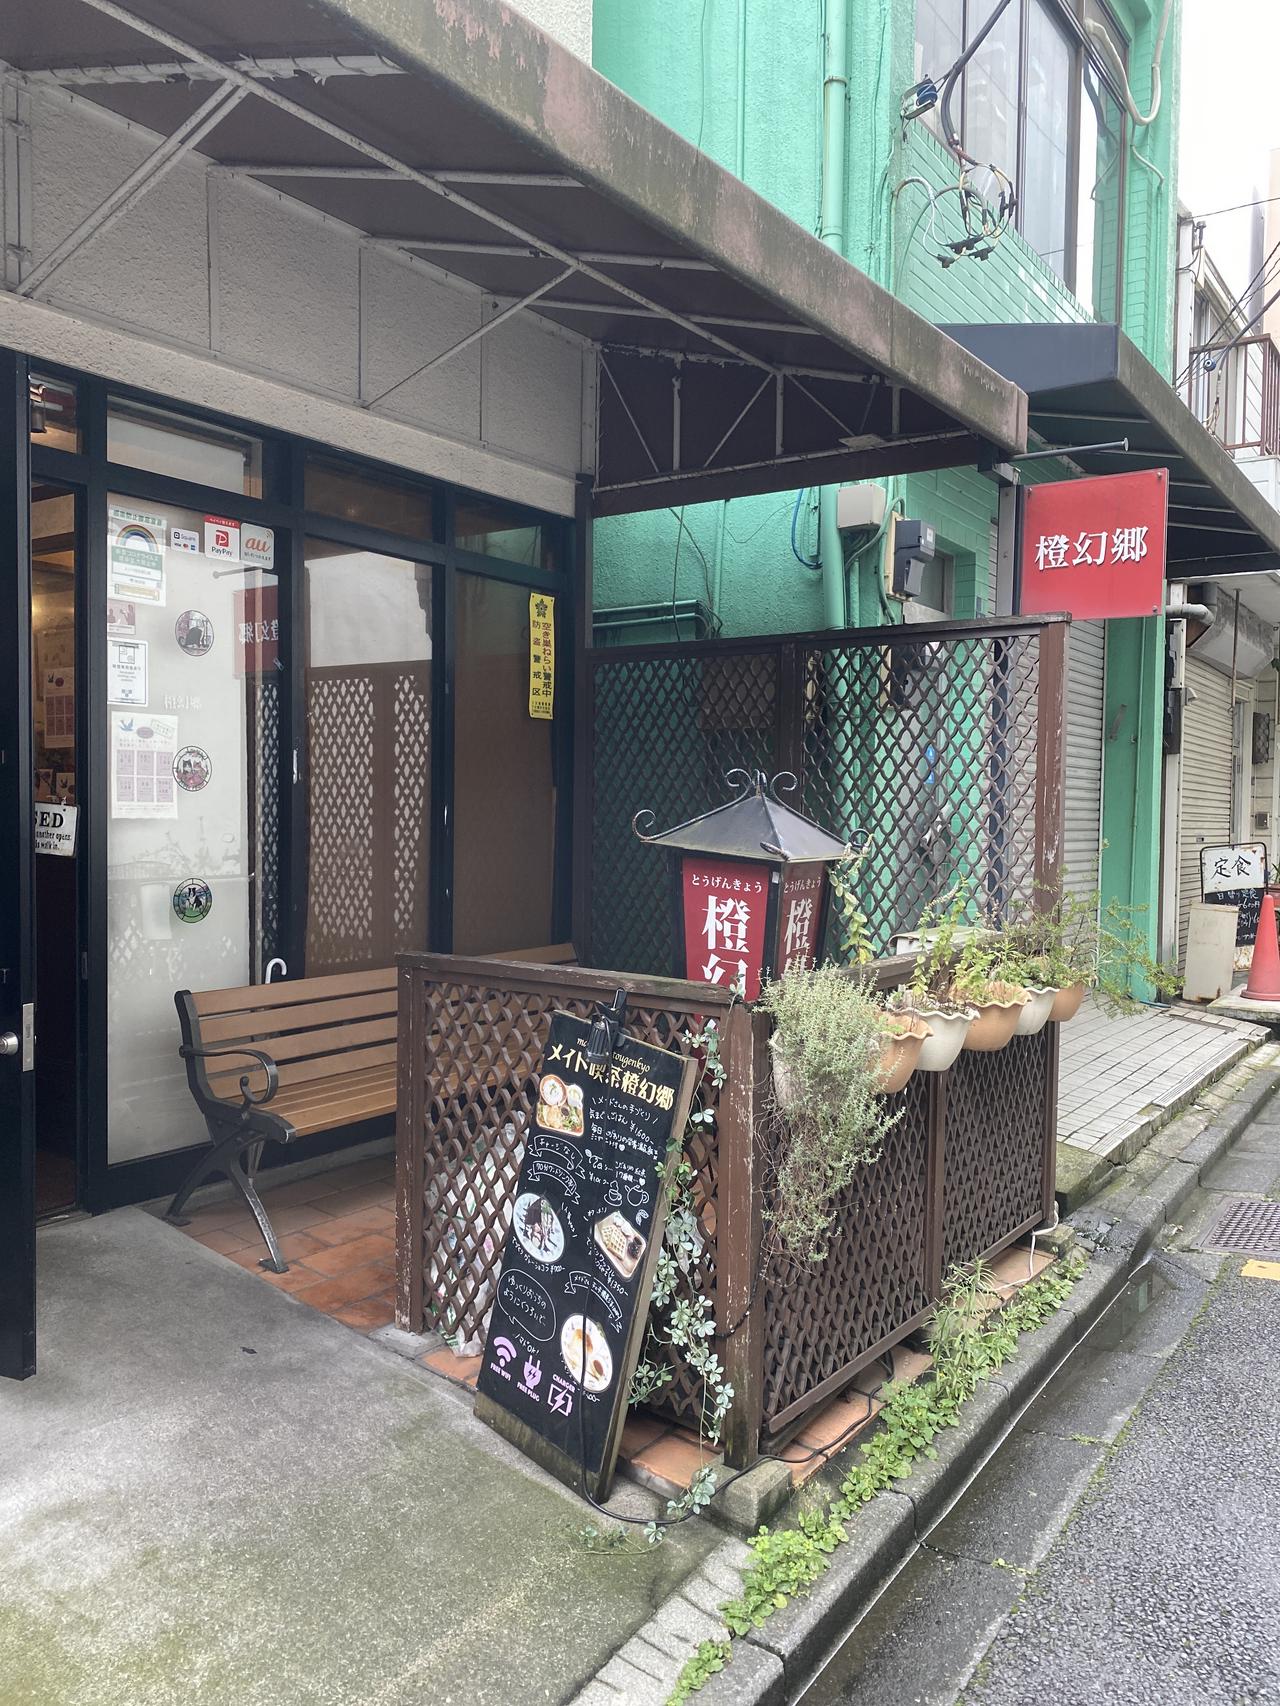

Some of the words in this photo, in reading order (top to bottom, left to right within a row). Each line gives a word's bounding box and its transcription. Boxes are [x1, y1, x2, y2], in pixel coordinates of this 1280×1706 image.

[211, 546, 233, 557] PayPay
[245, 538, 271, 553] au
[1034, 526, 1149, 571] 橙幻郷
[1211, 855, 1252, 880] 定食
[691, 873, 763, 894] とうげんきょう
[783, 876, 822, 895] とうげんきょう
[490, 1362, 502, 1374] FREE
[516, 1381, 531, 1394] FREE
[526, 1389, 540, 1402] PLUG
[552, 1373, 576, 1393] CHARGER
